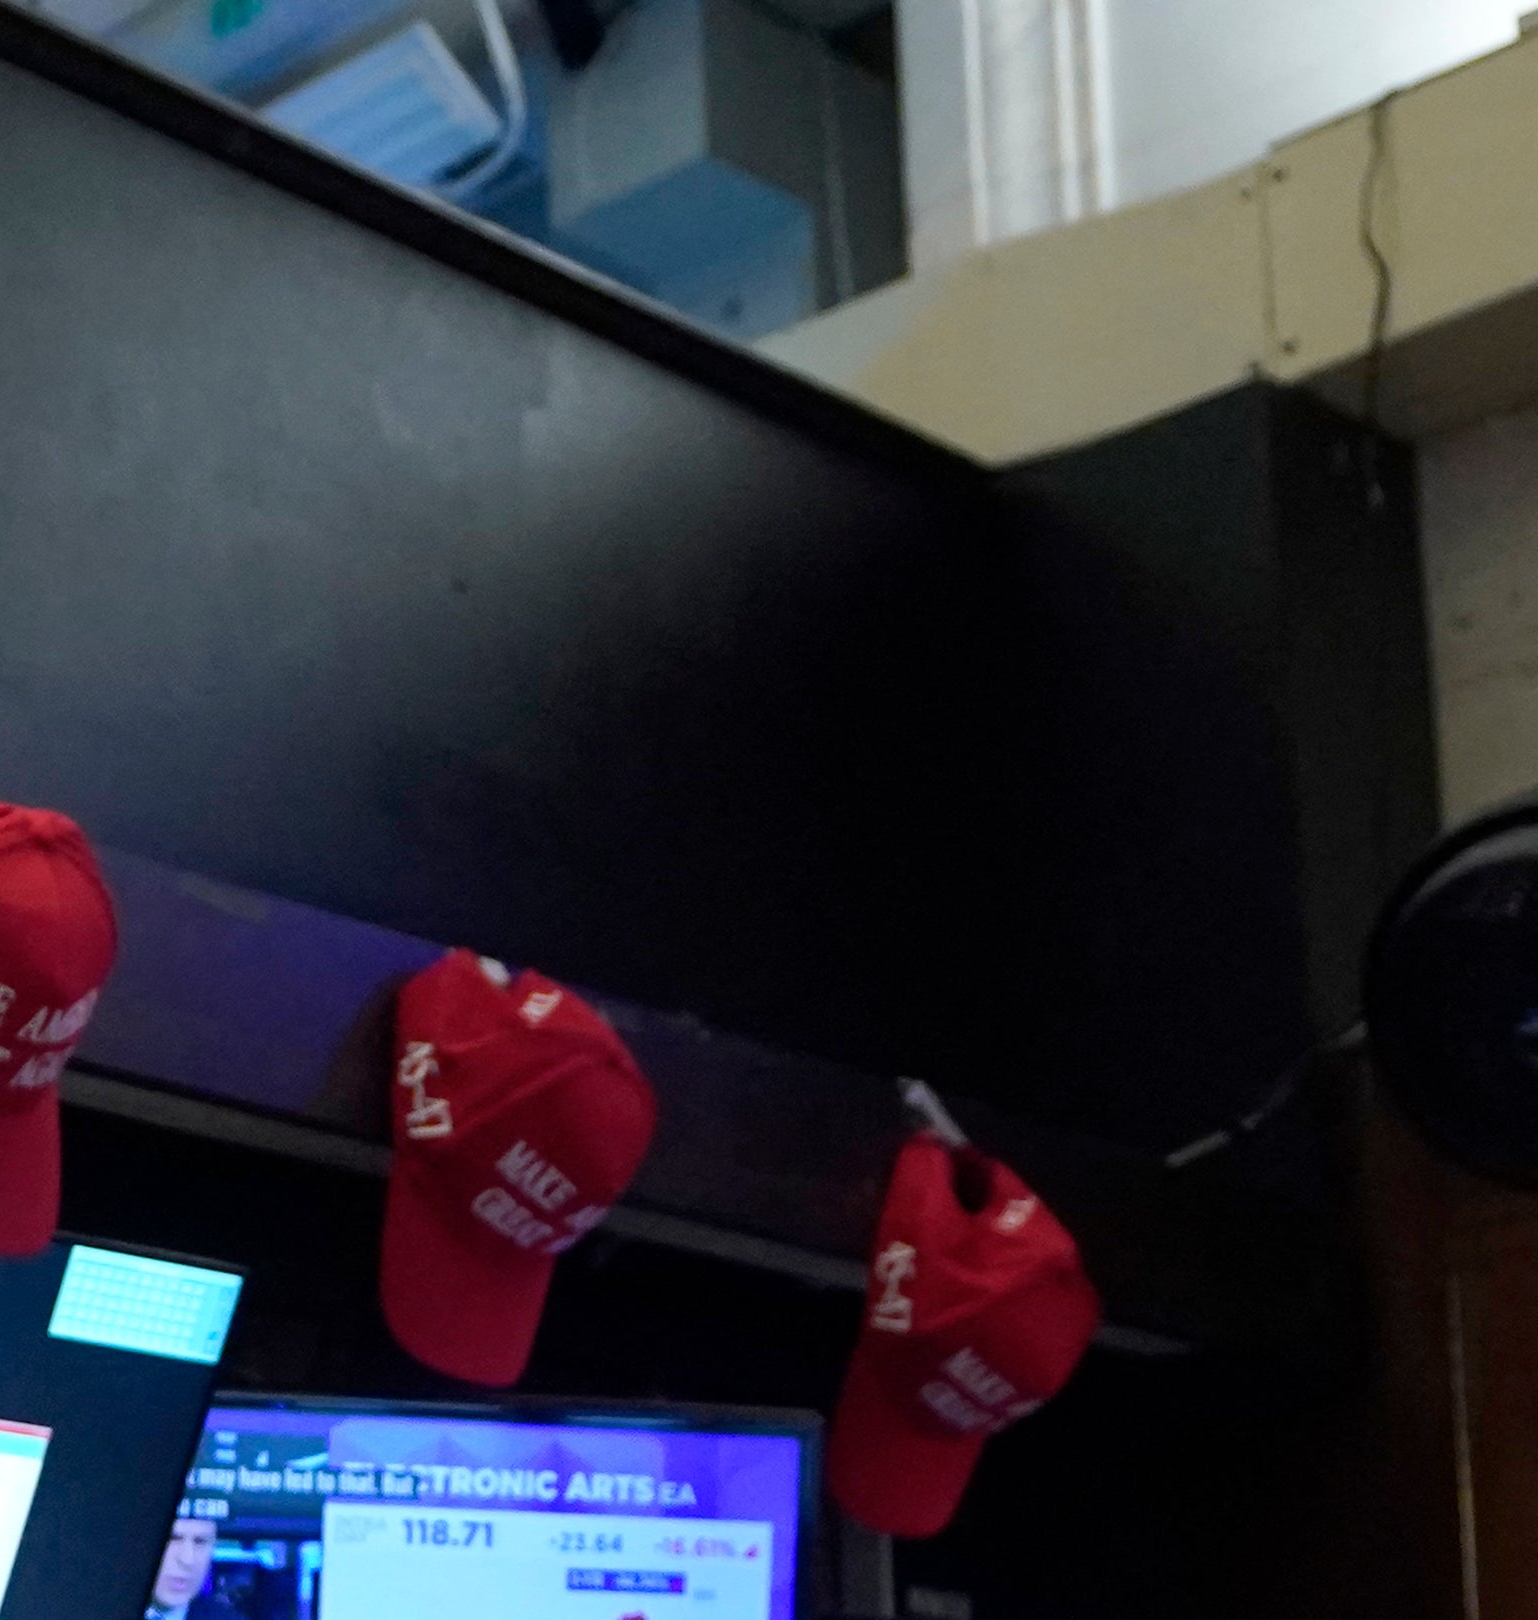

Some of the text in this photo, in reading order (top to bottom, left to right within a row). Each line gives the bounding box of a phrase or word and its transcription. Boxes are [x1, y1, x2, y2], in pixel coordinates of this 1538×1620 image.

[198, 1467, 236, 1494] may
[238, 1466, 282, 1492] have
[315, 1470, 336, 1493] to
[565, 1473, 655, 1502] ARTS
[658, 1482, 698, 1506] EA
[193, 1498, 229, 1518] can
[401, 1517, 495, 1548] 118.71
